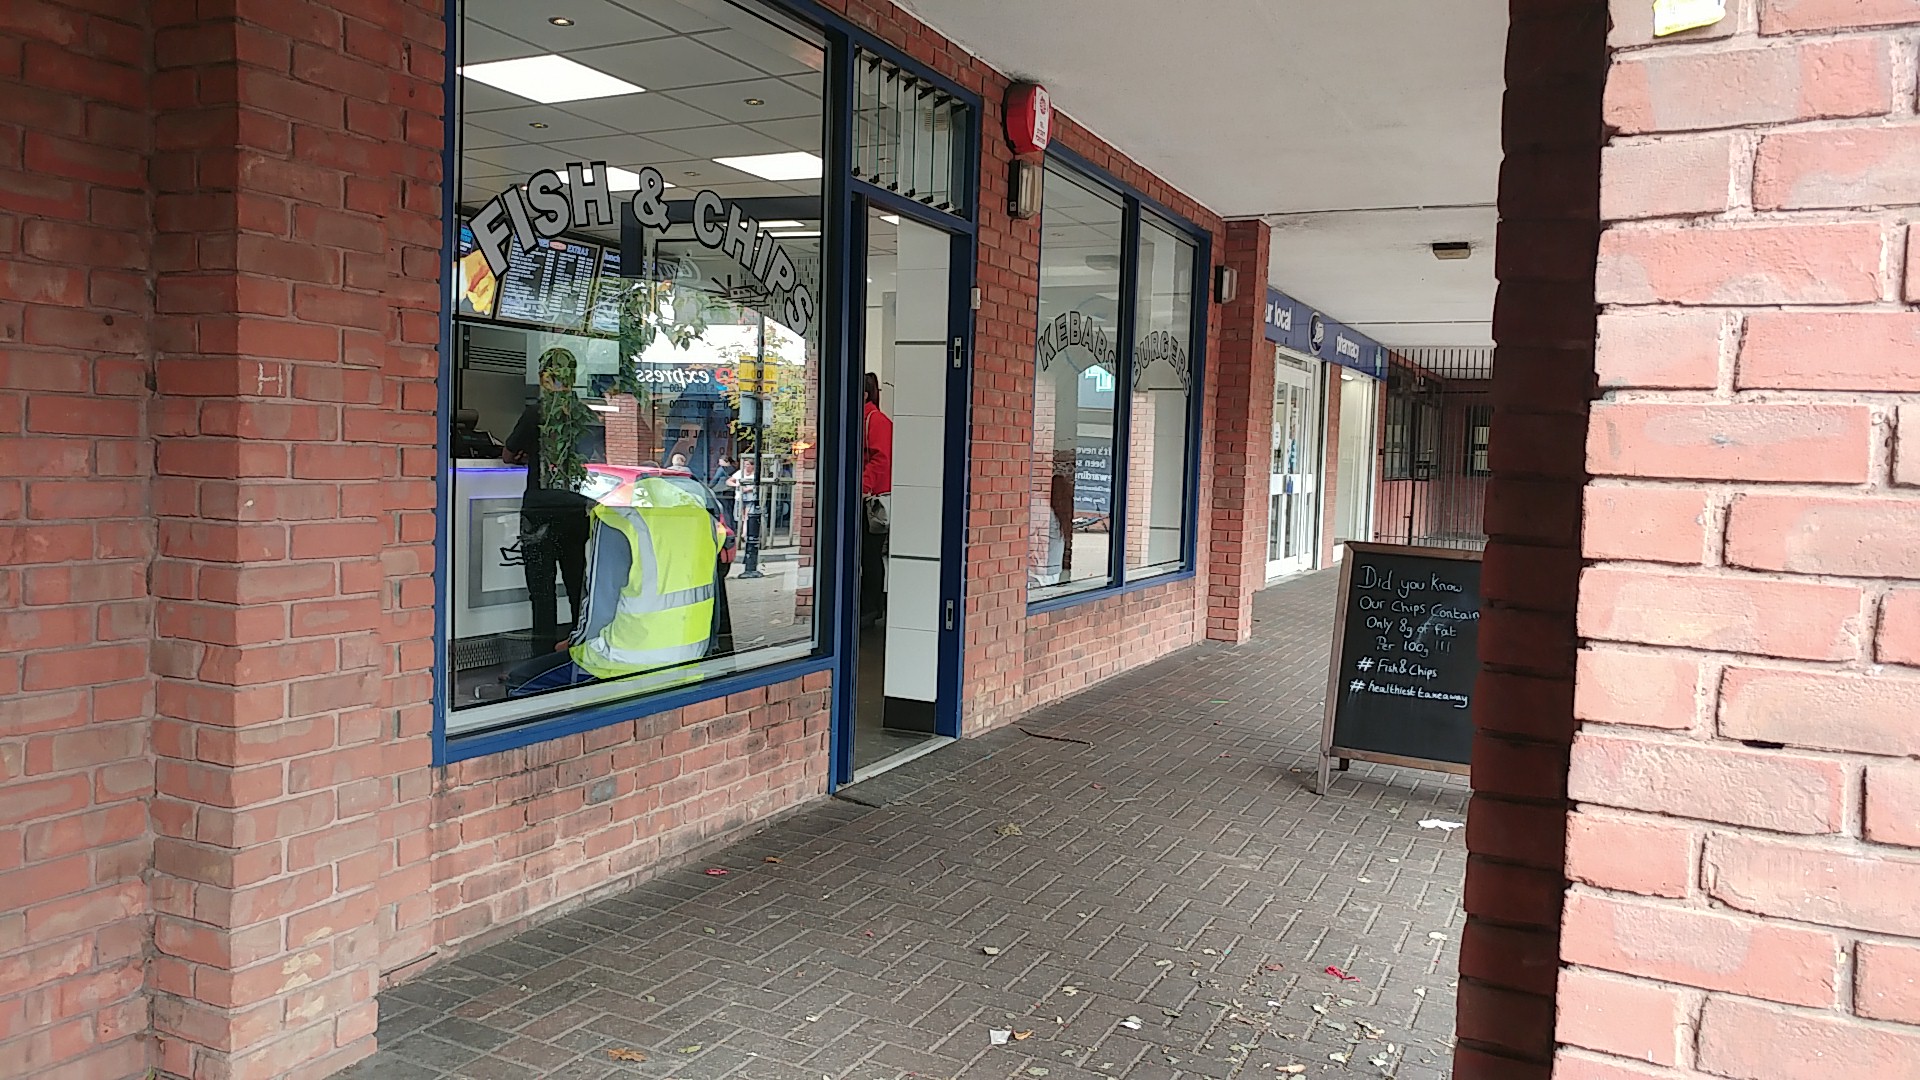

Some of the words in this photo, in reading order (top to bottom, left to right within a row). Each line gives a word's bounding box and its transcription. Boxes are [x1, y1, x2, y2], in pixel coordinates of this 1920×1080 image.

[467, 161, 613, 280] FISH
[632, 166, 672, 234] &
[692, 189, 814, 336] CHIPS
[1274, 300, 1292, 331] local
[1038, 310, 1116, 375] KEBABS
[1133, 330, 1192, 397] BURGERS
[1357, 565, 1393, 591] Did
[1397, 580, 1425, 598] you
[1430, 573, 1463, 593] Know
[1359, 595, 1385, 610] Our
[1391, 600, 1426, 616] Chips
[1430, 604, 1480, 621] Contain
[1366, 616, 1393, 635] Only
[1399, 617, 1413, 639] 8g
[1417, 621, 1431, 634] of
[1376, 635, 1396, 651] Per
[1403, 640, 1429, 658] 100g
